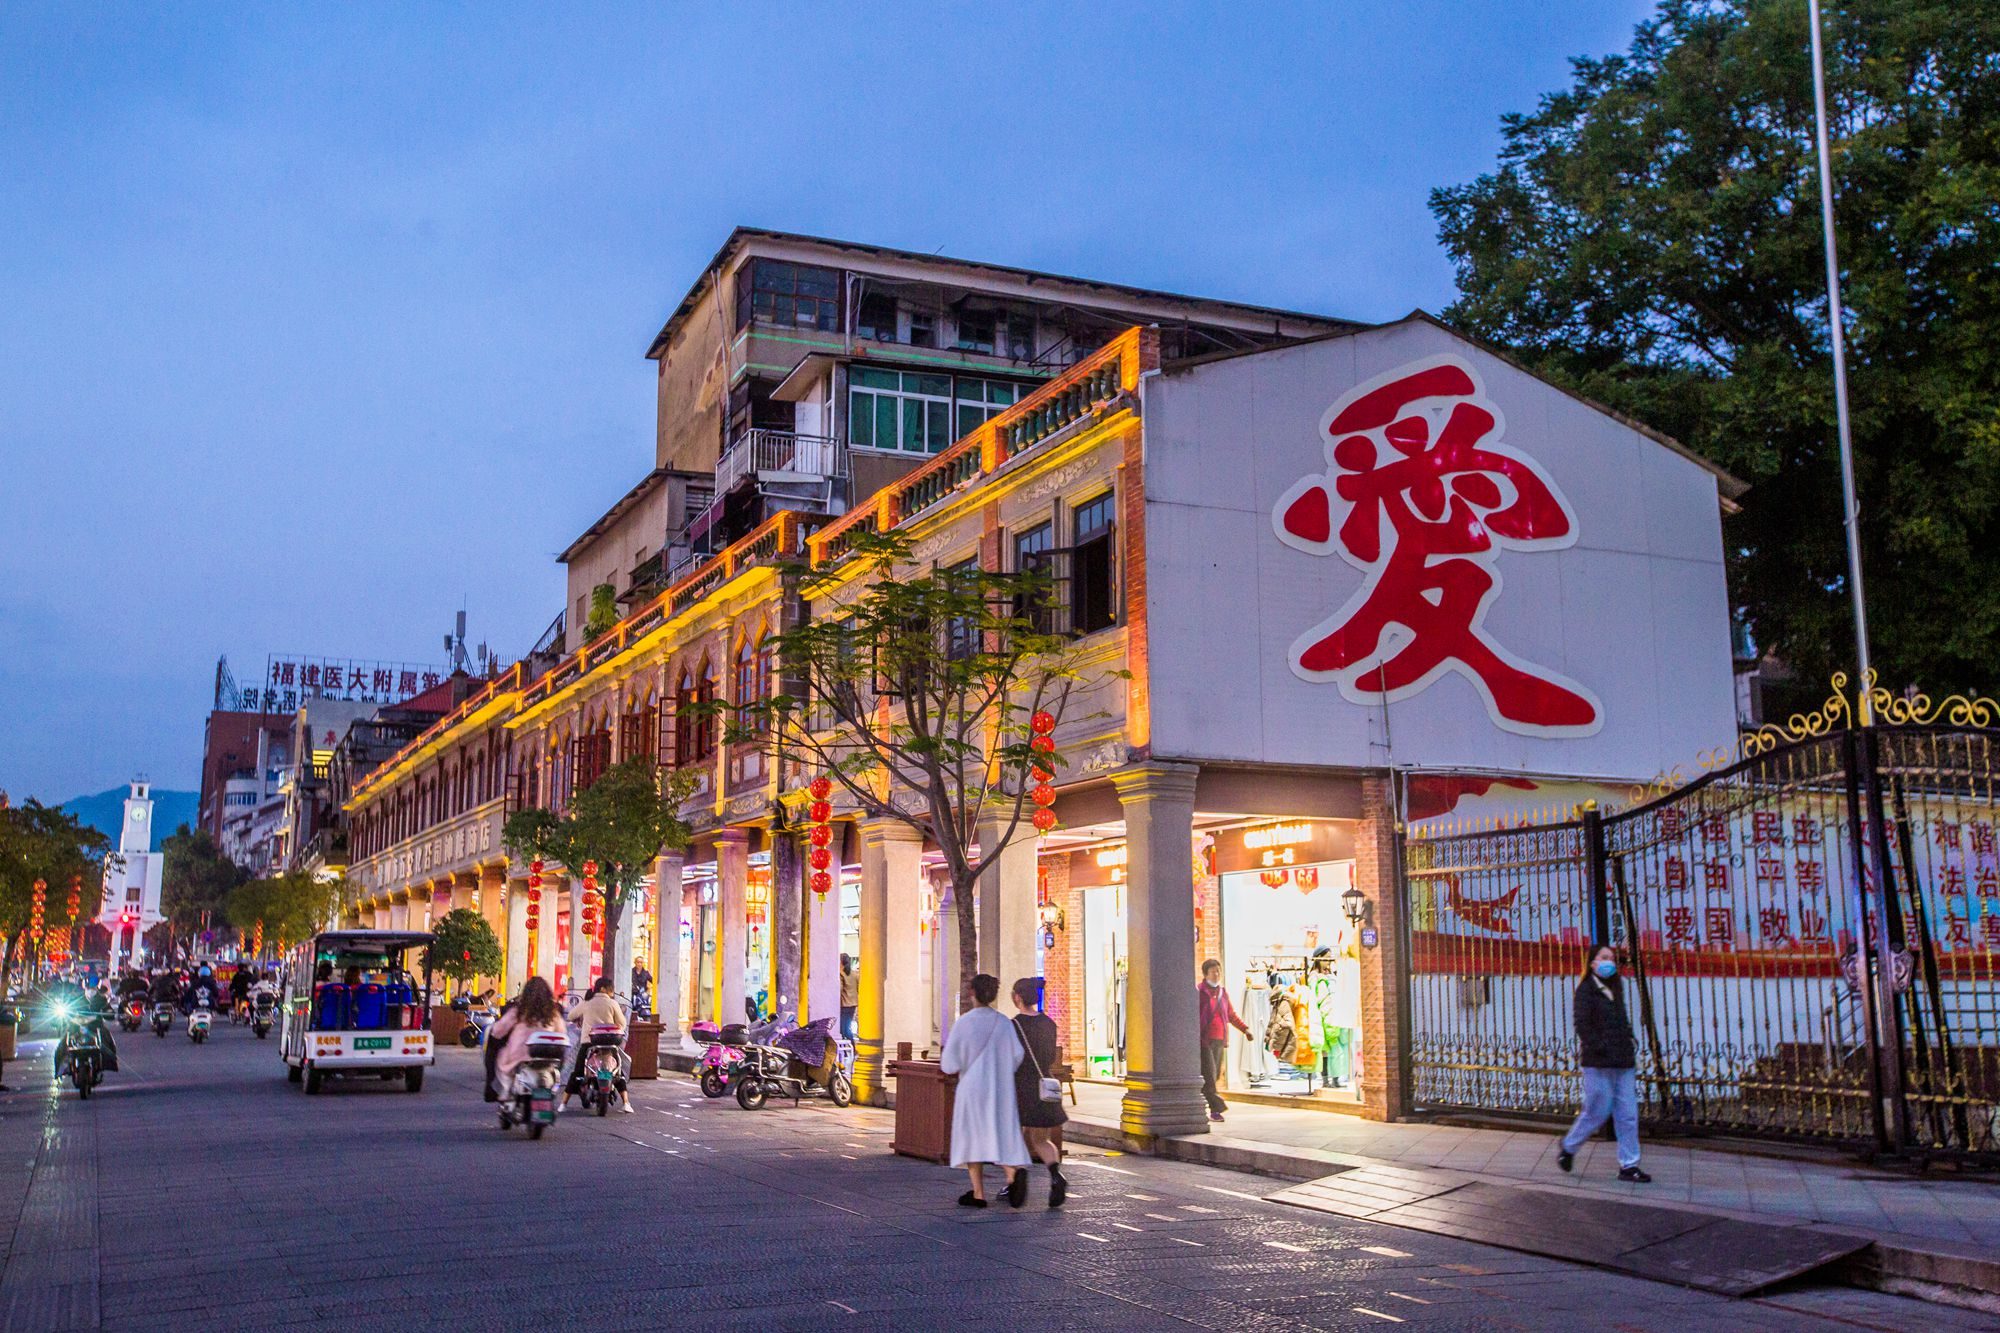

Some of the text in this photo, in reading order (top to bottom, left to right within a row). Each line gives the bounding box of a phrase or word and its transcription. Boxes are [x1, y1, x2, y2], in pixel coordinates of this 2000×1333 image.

[1753, 812, 1818, 844] 民主
[1934, 820, 1993, 854] 和谐
[1664, 857, 1728, 890] 自由
[1757, 858, 1821, 893] 平等
[1938, 865, 1999, 898] 法治
[1664, 907, 1732, 941] 爱国
[1760, 908, 1826, 941] 敬业
[1944, 913, 2000, 947] 友善
